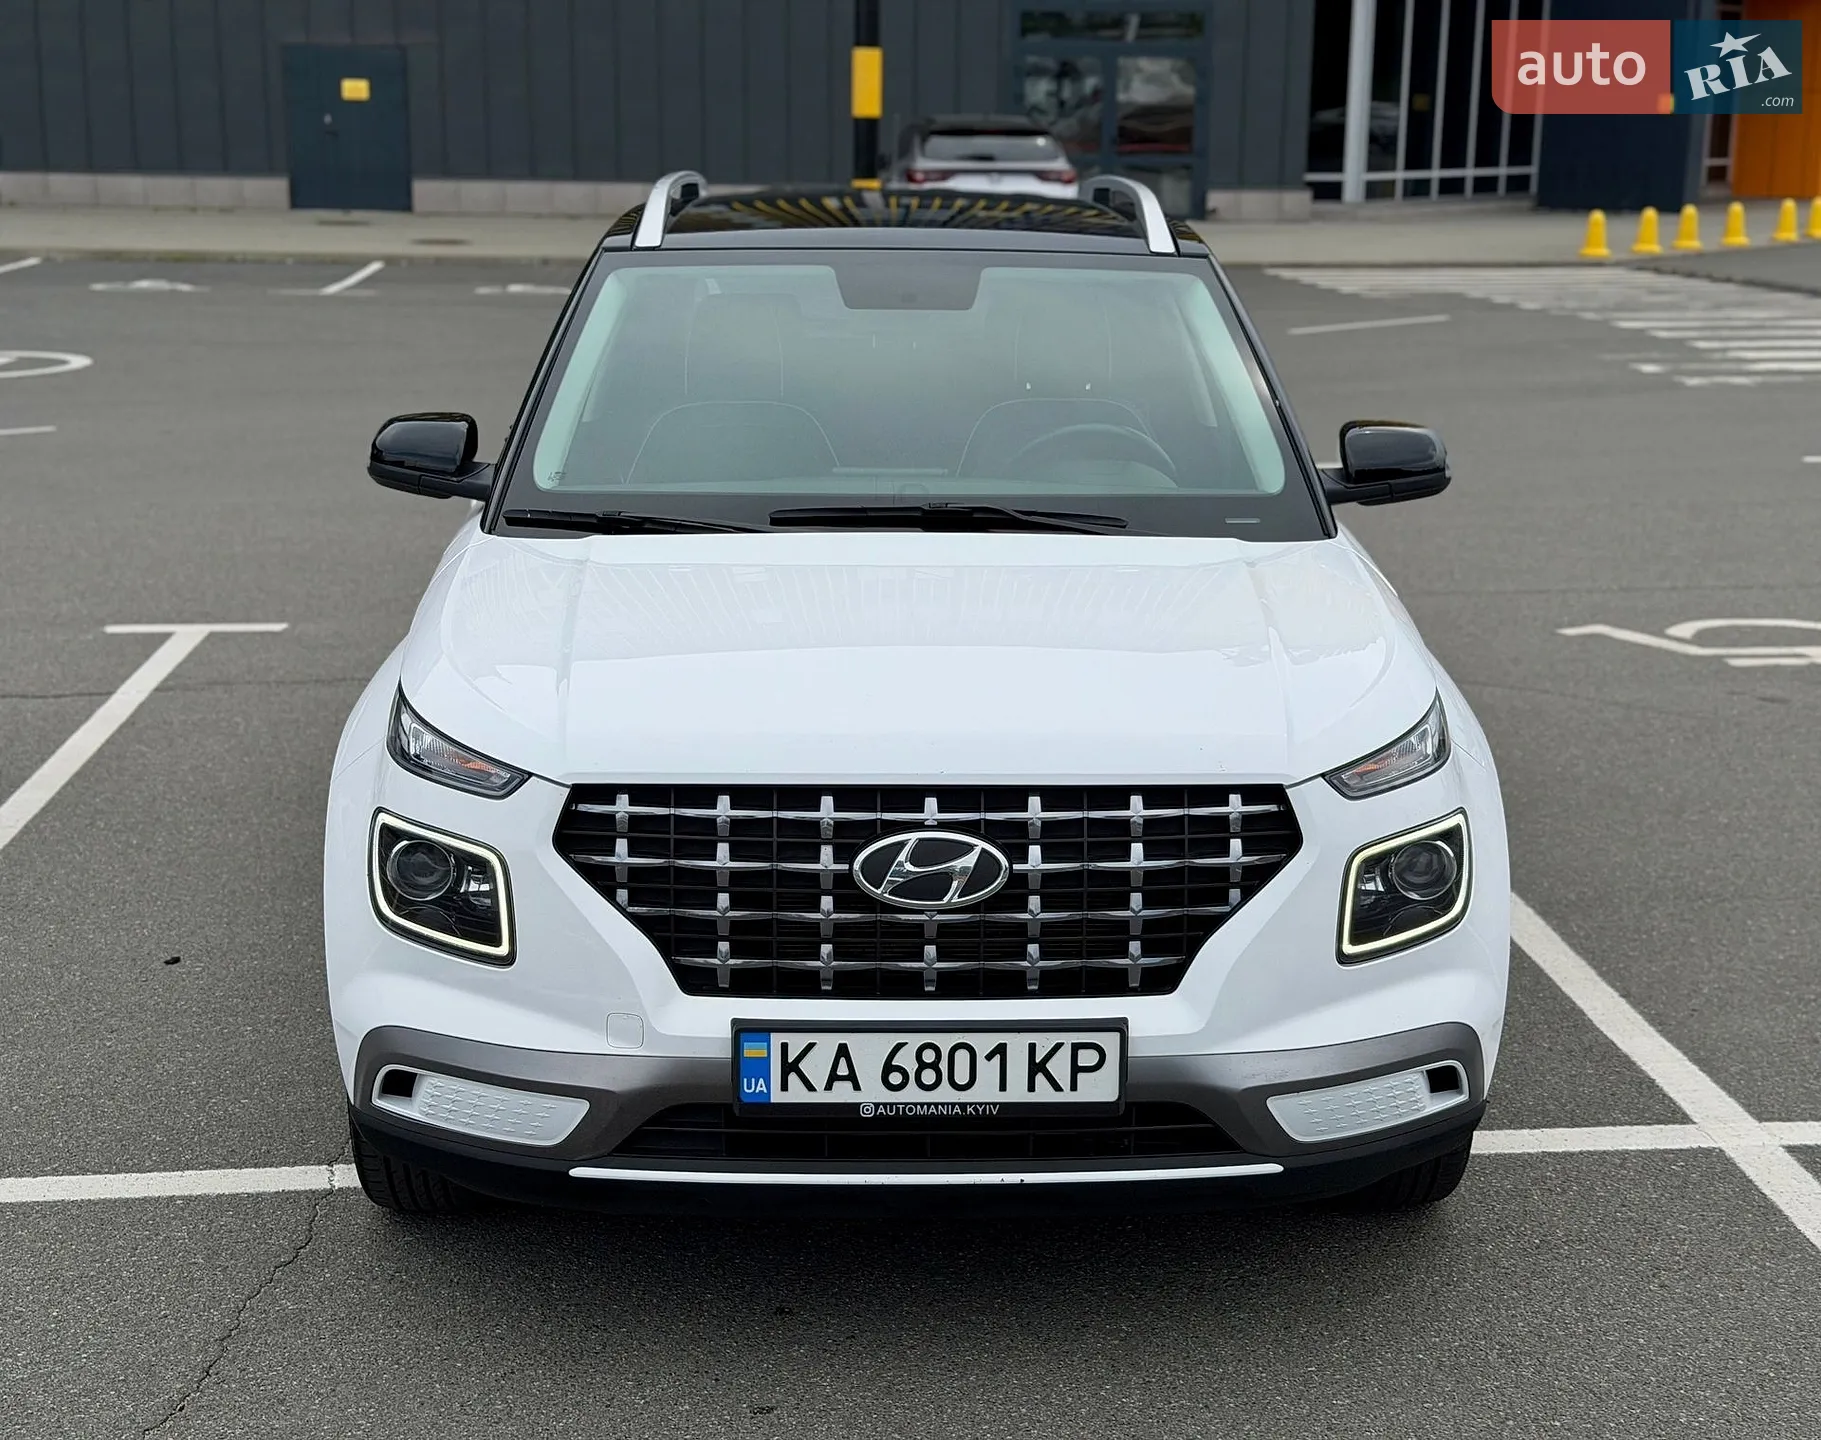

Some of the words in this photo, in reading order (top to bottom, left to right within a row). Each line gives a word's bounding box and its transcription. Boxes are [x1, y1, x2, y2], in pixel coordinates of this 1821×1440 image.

[779, 1041, 862, 1093] KA
[880, 1041, 1008, 1093] 6801
[1026, 1041, 1107, 1093] KP
[743, 1078, 768, 1094] UA
[876, 1103, 1000, 1117] AUTOMANIA.KYIV
